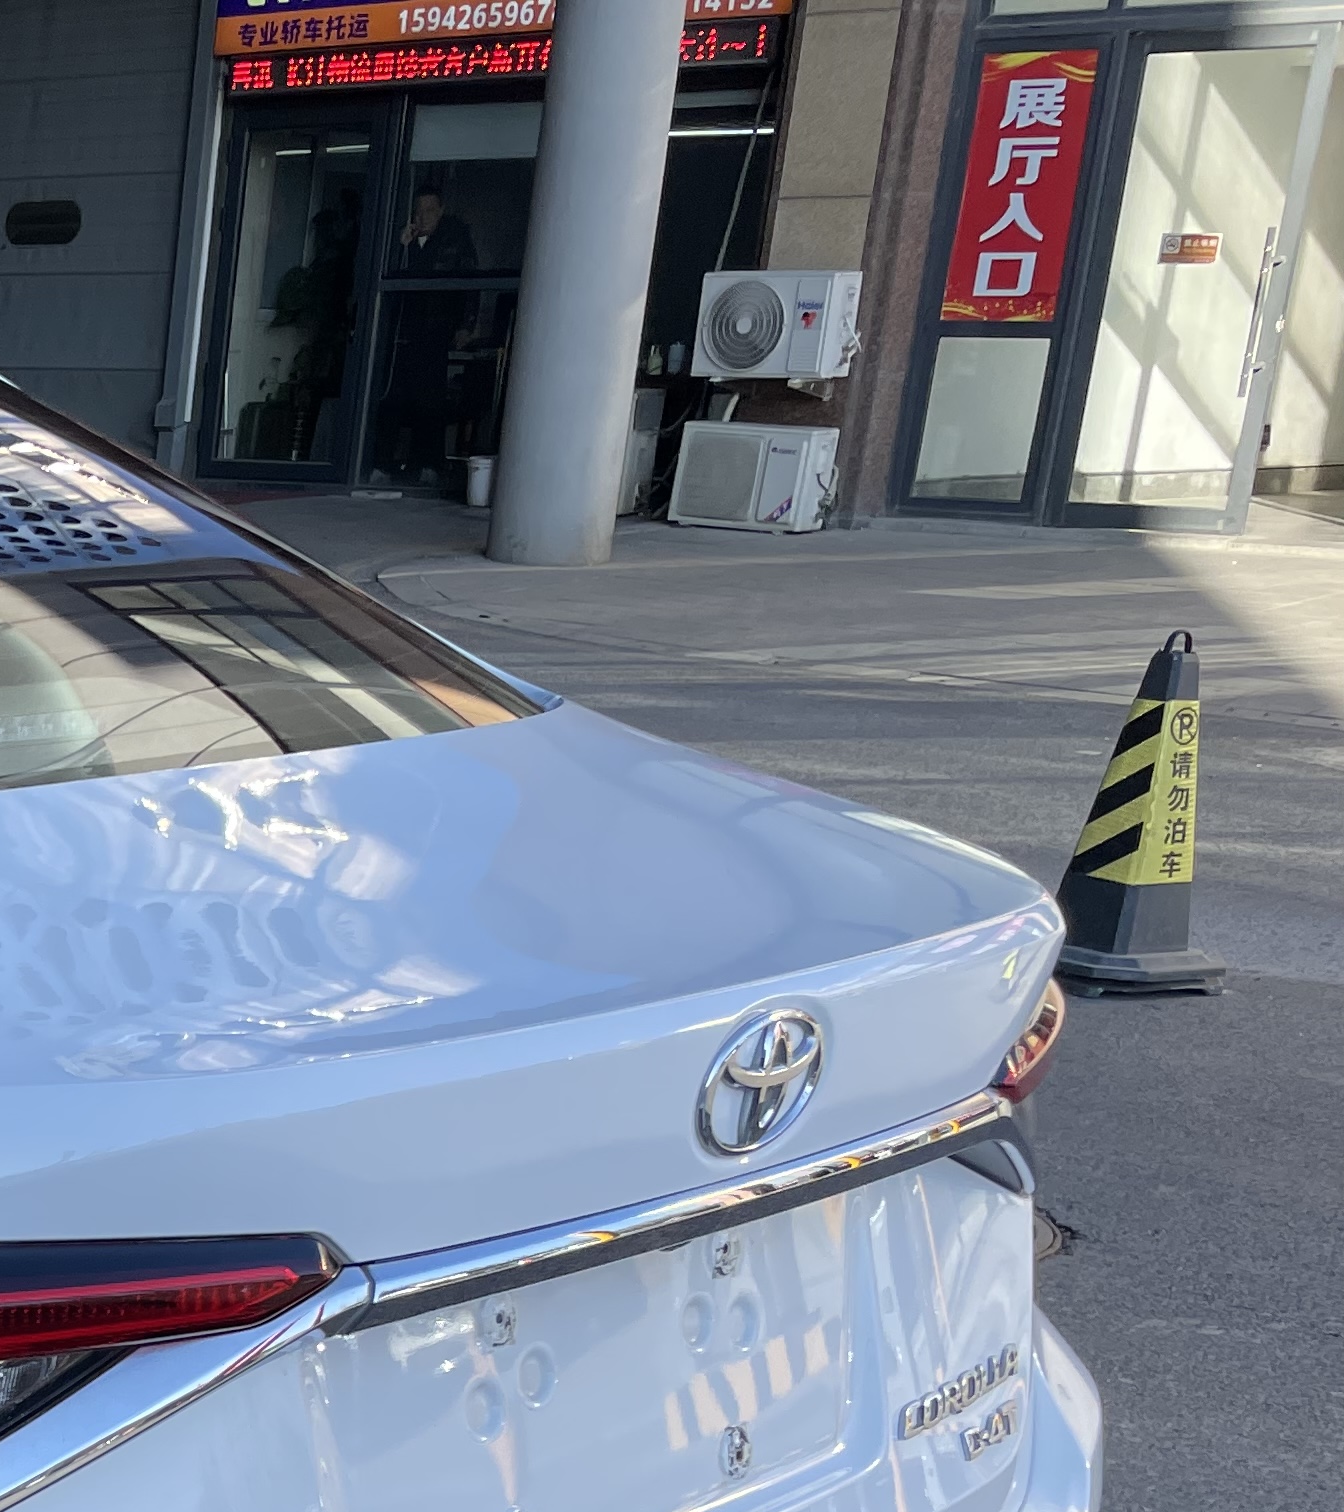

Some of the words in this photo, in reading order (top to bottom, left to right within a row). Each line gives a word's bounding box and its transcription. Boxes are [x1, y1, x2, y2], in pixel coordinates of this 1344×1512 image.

[238, 13, 369, 47] 专业轿车托运
[398, 0, 555, 34] 1594265967
[972, 78, 1067, 297] 展厅入口
[1159, 752, 1193, 878] 请勿泊车
[897, 1343, 1018, 1441] COROLLA
